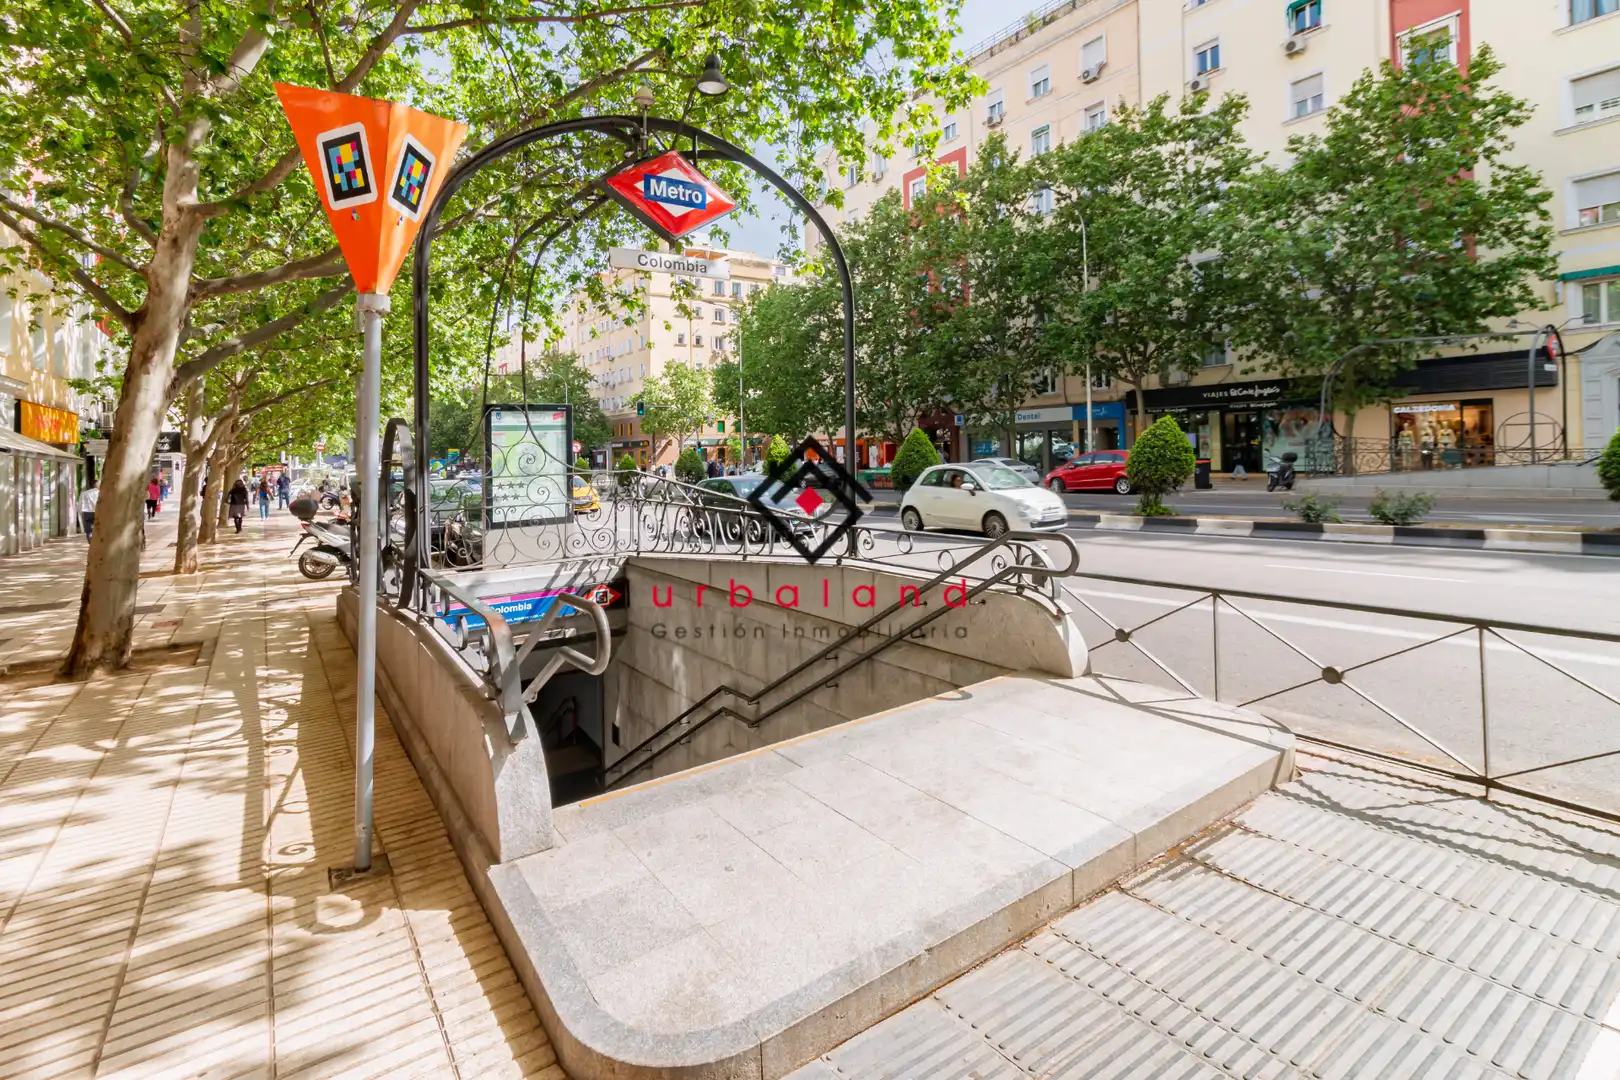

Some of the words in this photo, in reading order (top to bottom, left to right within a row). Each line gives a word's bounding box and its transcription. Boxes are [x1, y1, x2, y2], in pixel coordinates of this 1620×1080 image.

[649, 179, 703, 203] Metro
[638, 254, 707, 273] Colombia
[1394, 404, 1456, 413] CALZEDONIA
[1017, 412, 1041, 420] Dental
[492, 603, 532, 613] olombia
